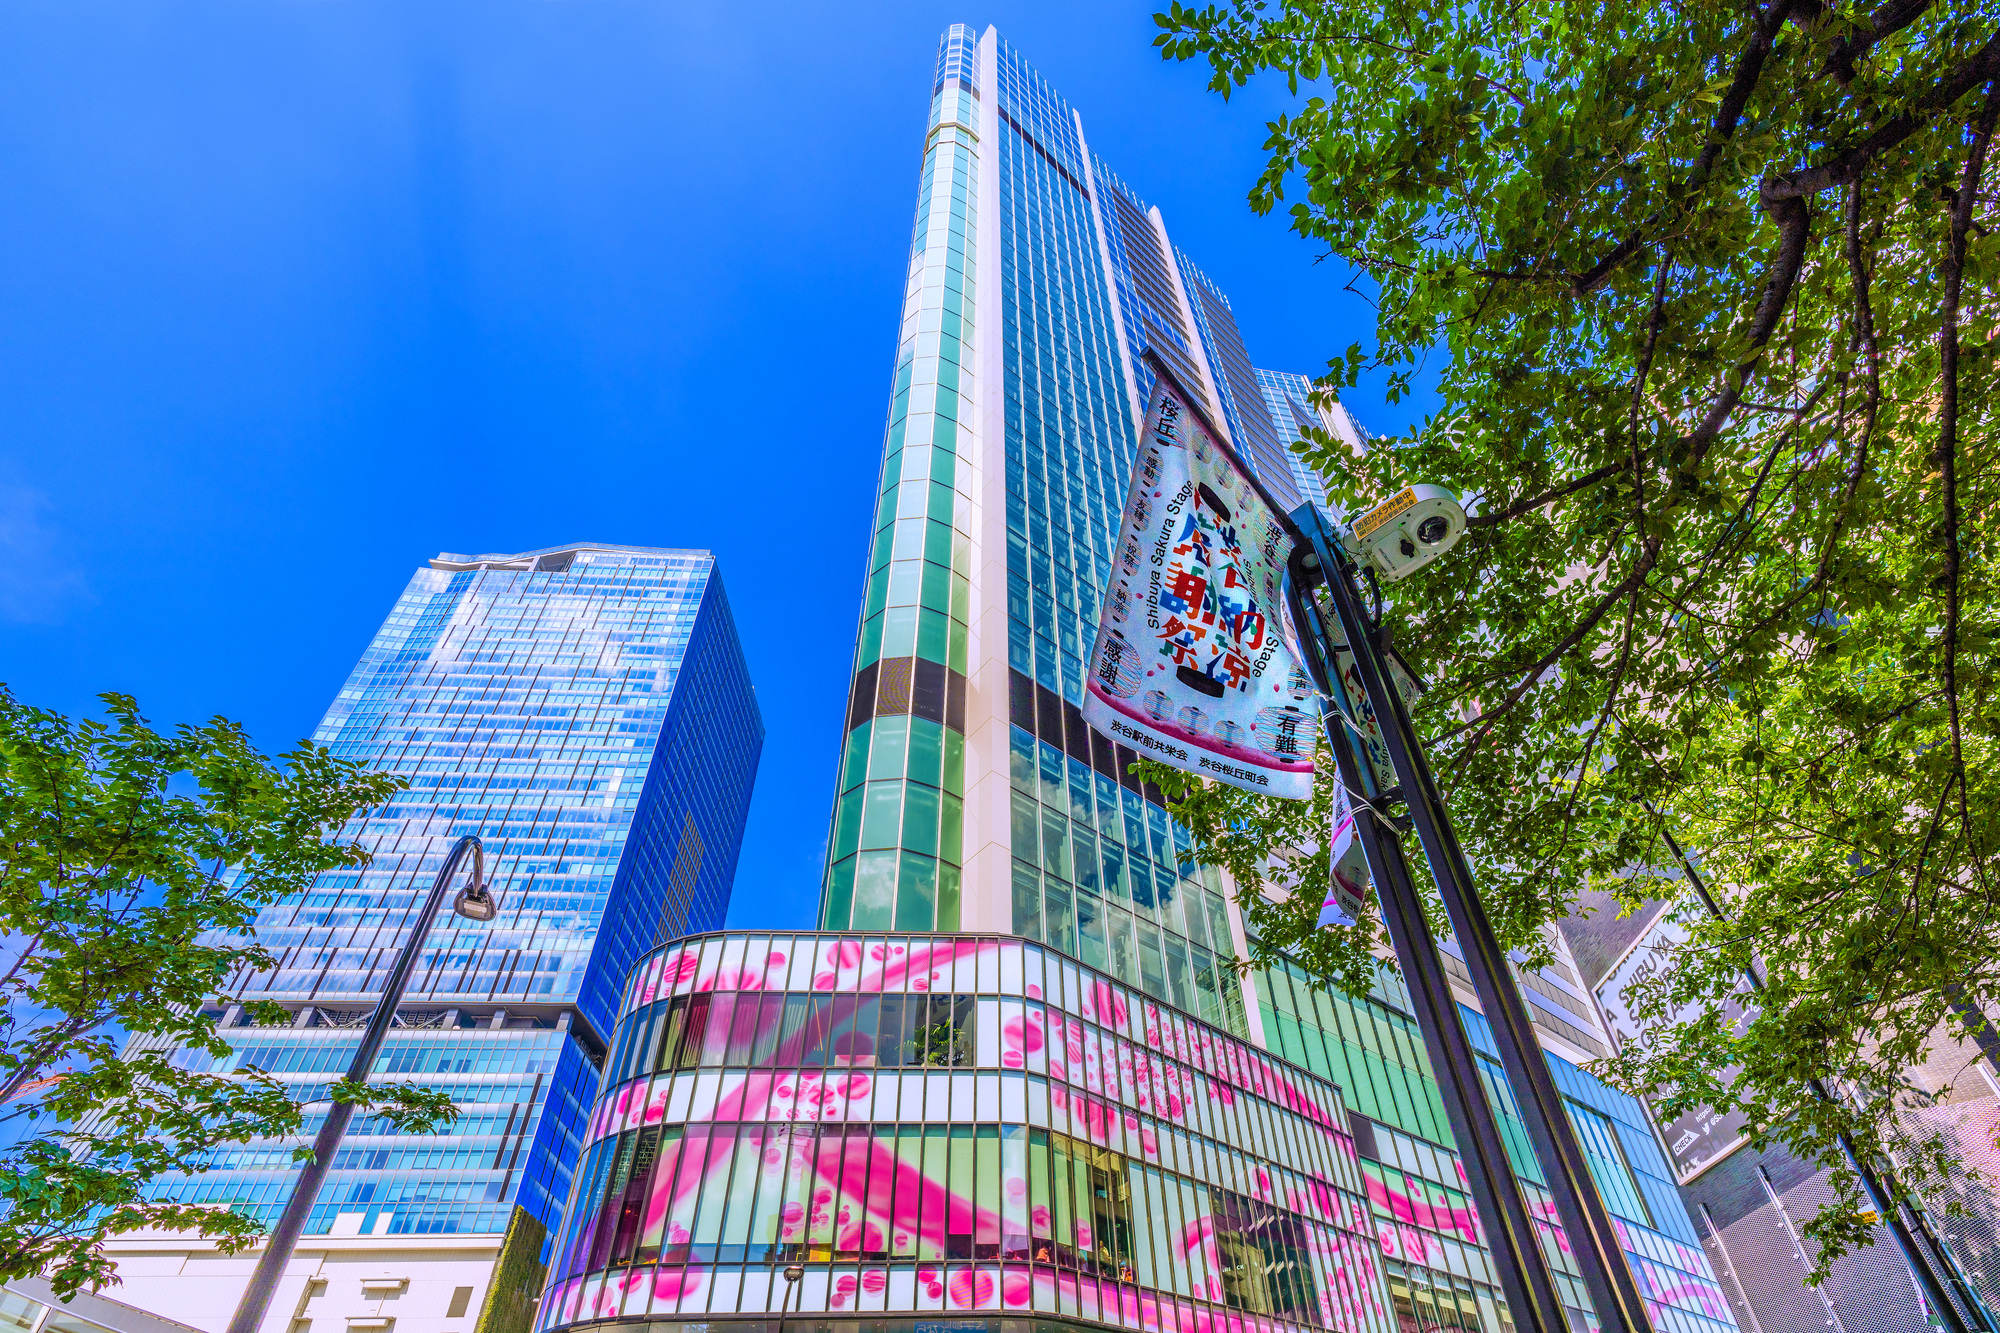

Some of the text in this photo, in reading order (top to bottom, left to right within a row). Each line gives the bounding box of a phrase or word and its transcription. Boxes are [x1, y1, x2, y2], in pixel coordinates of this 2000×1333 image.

[1153, 397, 1180, 440] 桜丘
[1354, 491, 1411, 532] 防犯カメラ作動中
[1146, 480, 1193, 630] Shibuya Sakura Stage
[1264, 521, 1281, 560] 渋谷
[1099, 639, 1123, 686] 感謝
[1253, 636, 1279, 678] Stage
[1110, 718, 1189, 762] 渋谷駅前共栄会
[1274, 716, 1300, 754] 有難
[1198, 756, 1270, 787] 渋谷桜丘町会
[1674, 1133, 1693, 1153] CHECK
